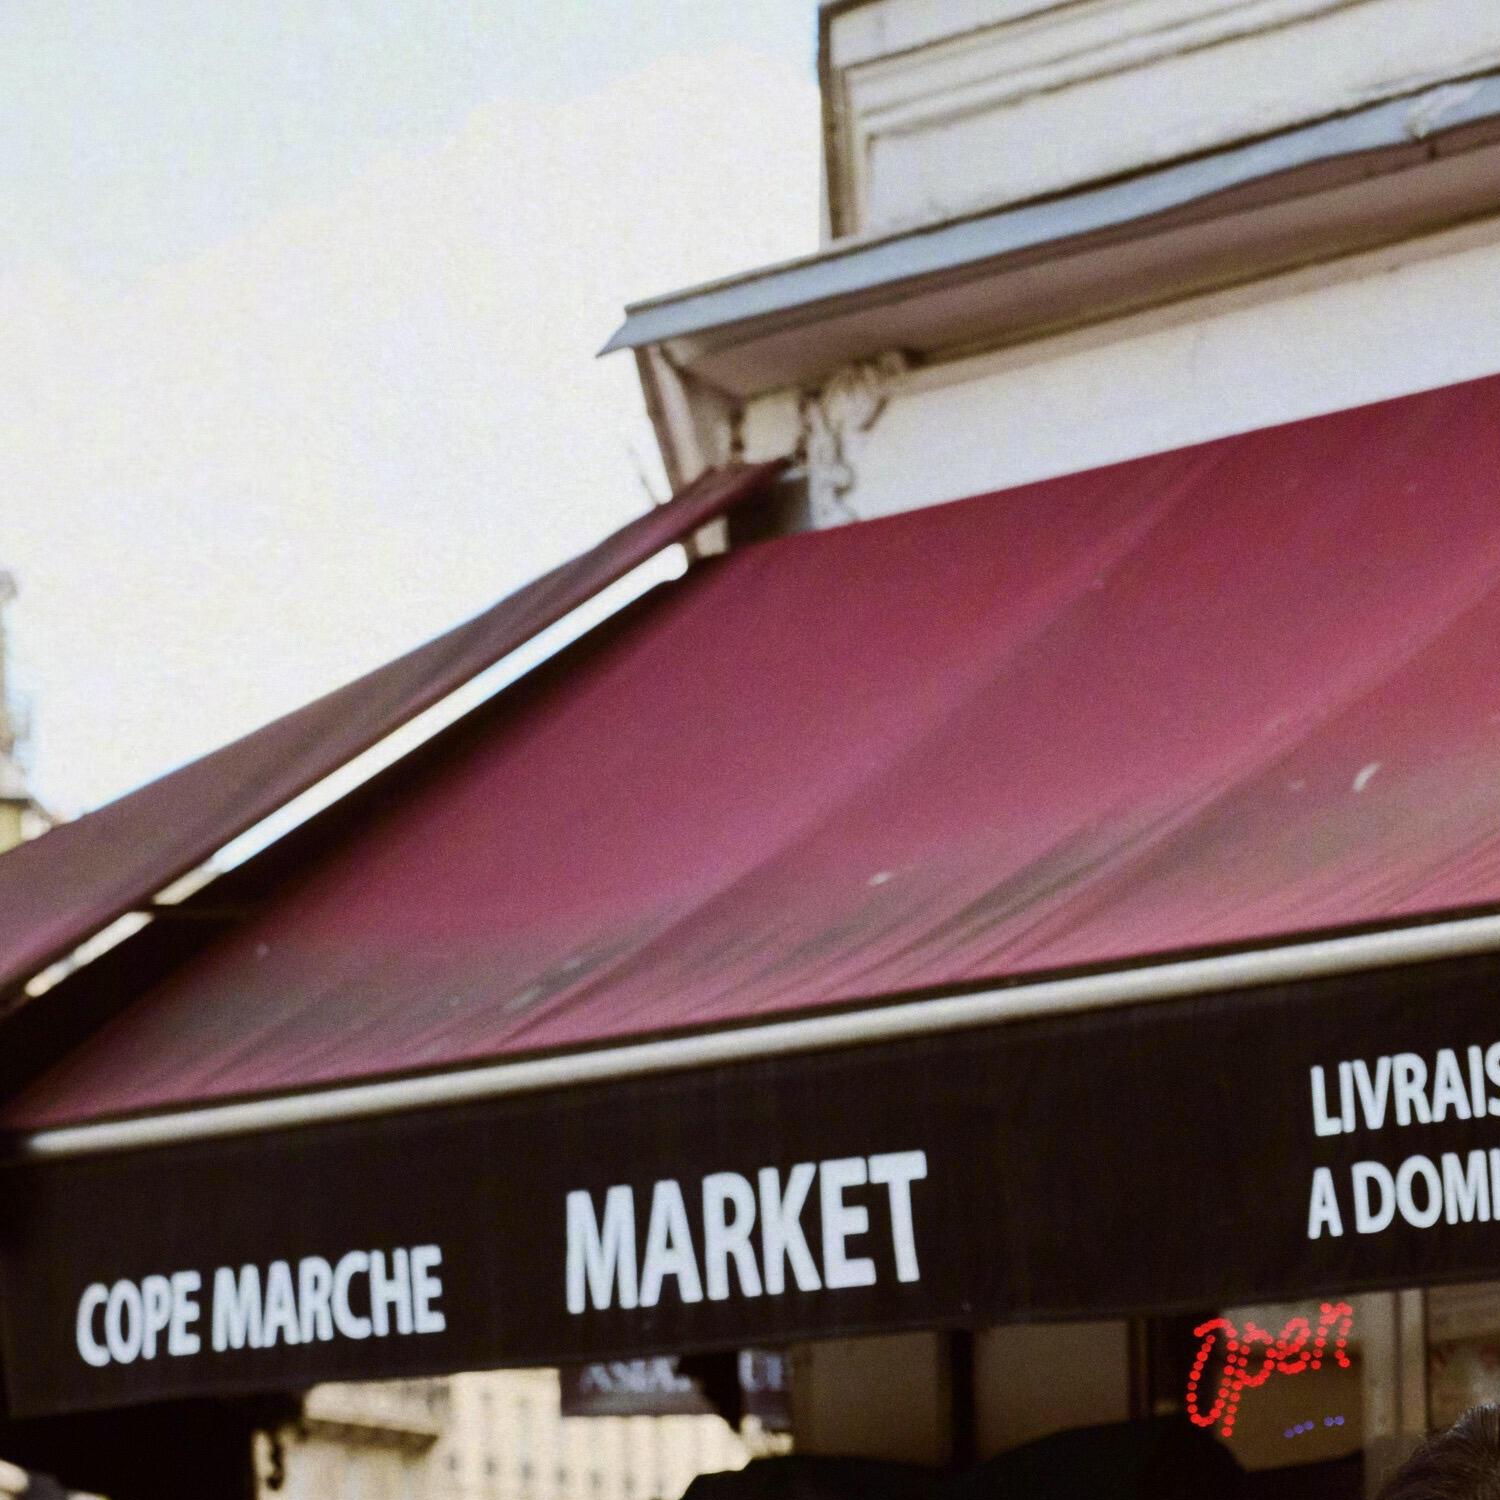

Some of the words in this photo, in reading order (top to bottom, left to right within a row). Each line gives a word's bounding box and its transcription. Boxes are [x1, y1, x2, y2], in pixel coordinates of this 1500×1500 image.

[566, 1150, 928, 1314] MARKET
[1308, 1167, 1344, 1240] A
[76, 1270, 201, 1367] COPE
[212, 1245, 446, 1352] MARCHE
[1185, 1302, 1352, 1437] Open
